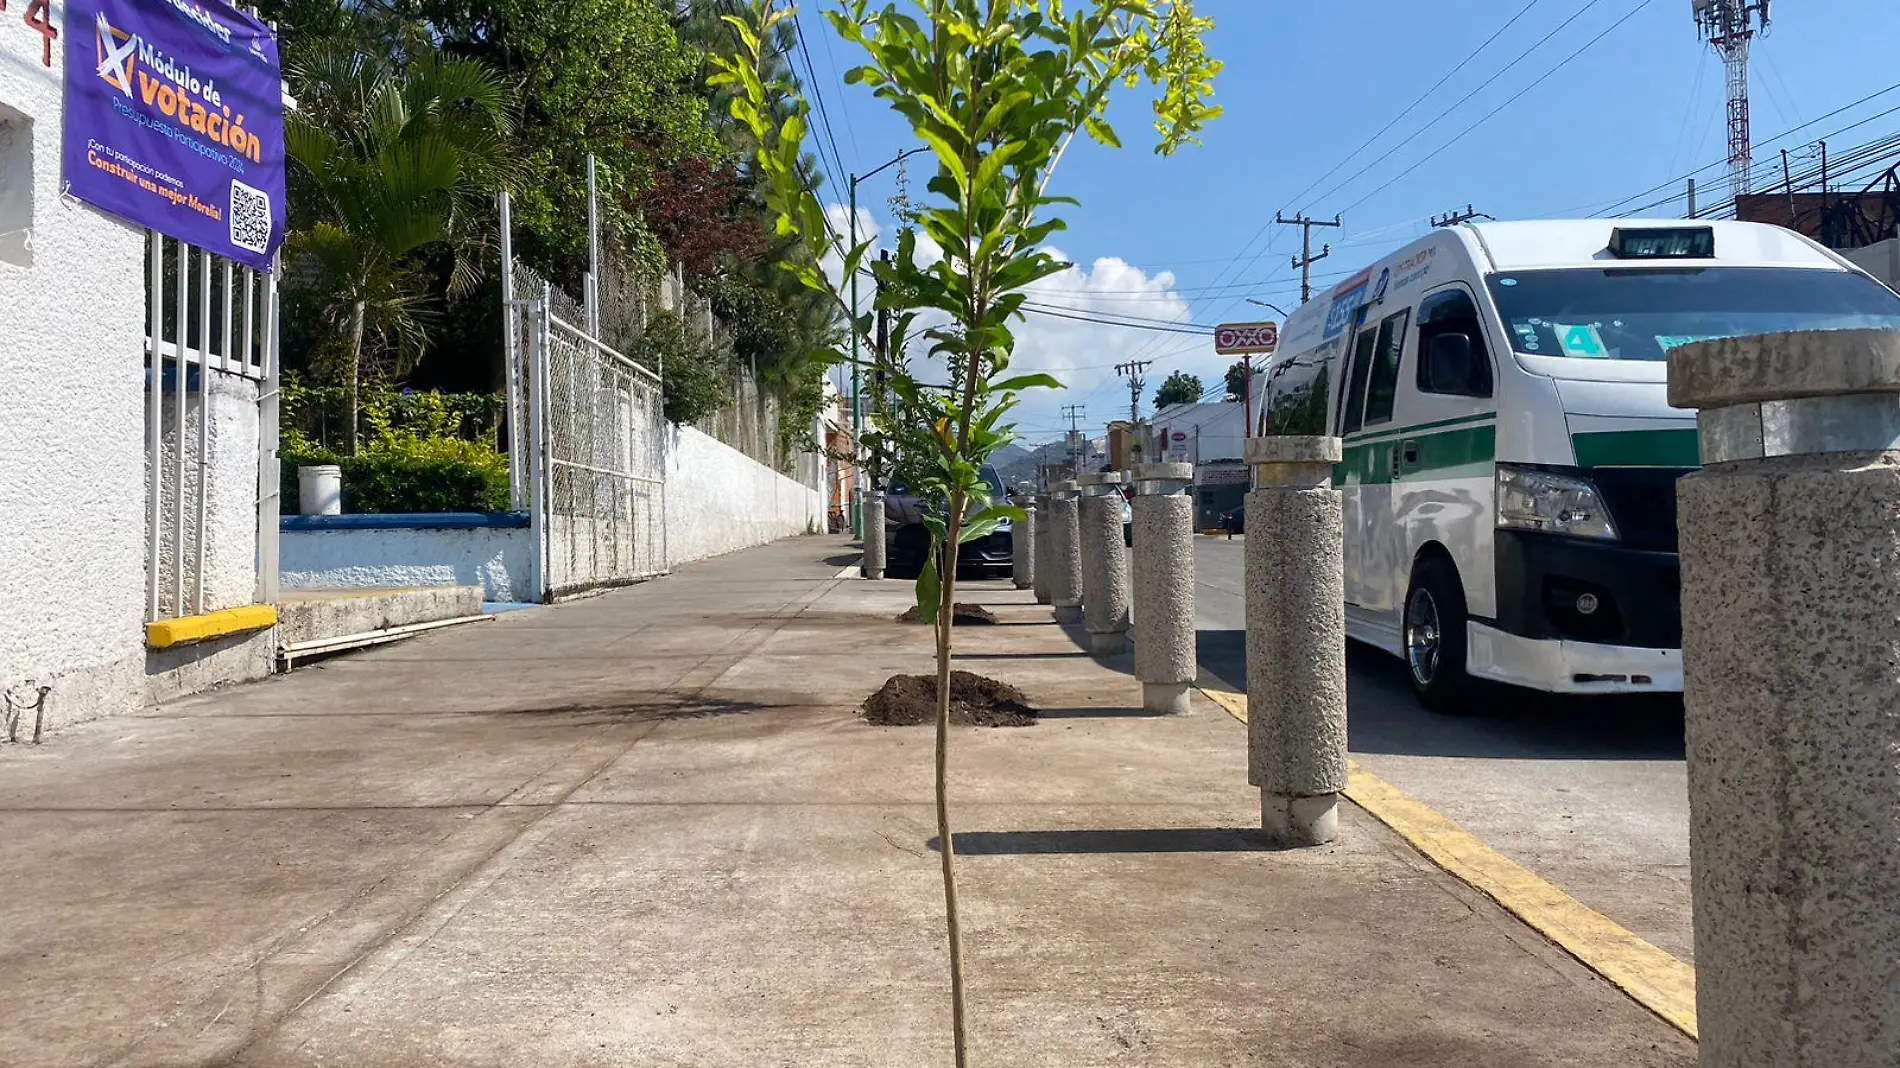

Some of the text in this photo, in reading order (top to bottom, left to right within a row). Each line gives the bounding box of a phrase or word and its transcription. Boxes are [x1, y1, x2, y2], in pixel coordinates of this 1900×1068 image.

[138, 37, 202, 93] Módulo
[202, 81, 222, 107] de
[113, 96, 173, 138] Presupuesto
[175, 128, 228, 166] Participativo
[139, 70, 261, 163] votación
[88, 150, 222, 221] Construir una mejor Morelia!
[106, 145, 115, 157] tu
[155, 169, 184, 189] podemos
[1219, 328, 1275, 349] OXXO
